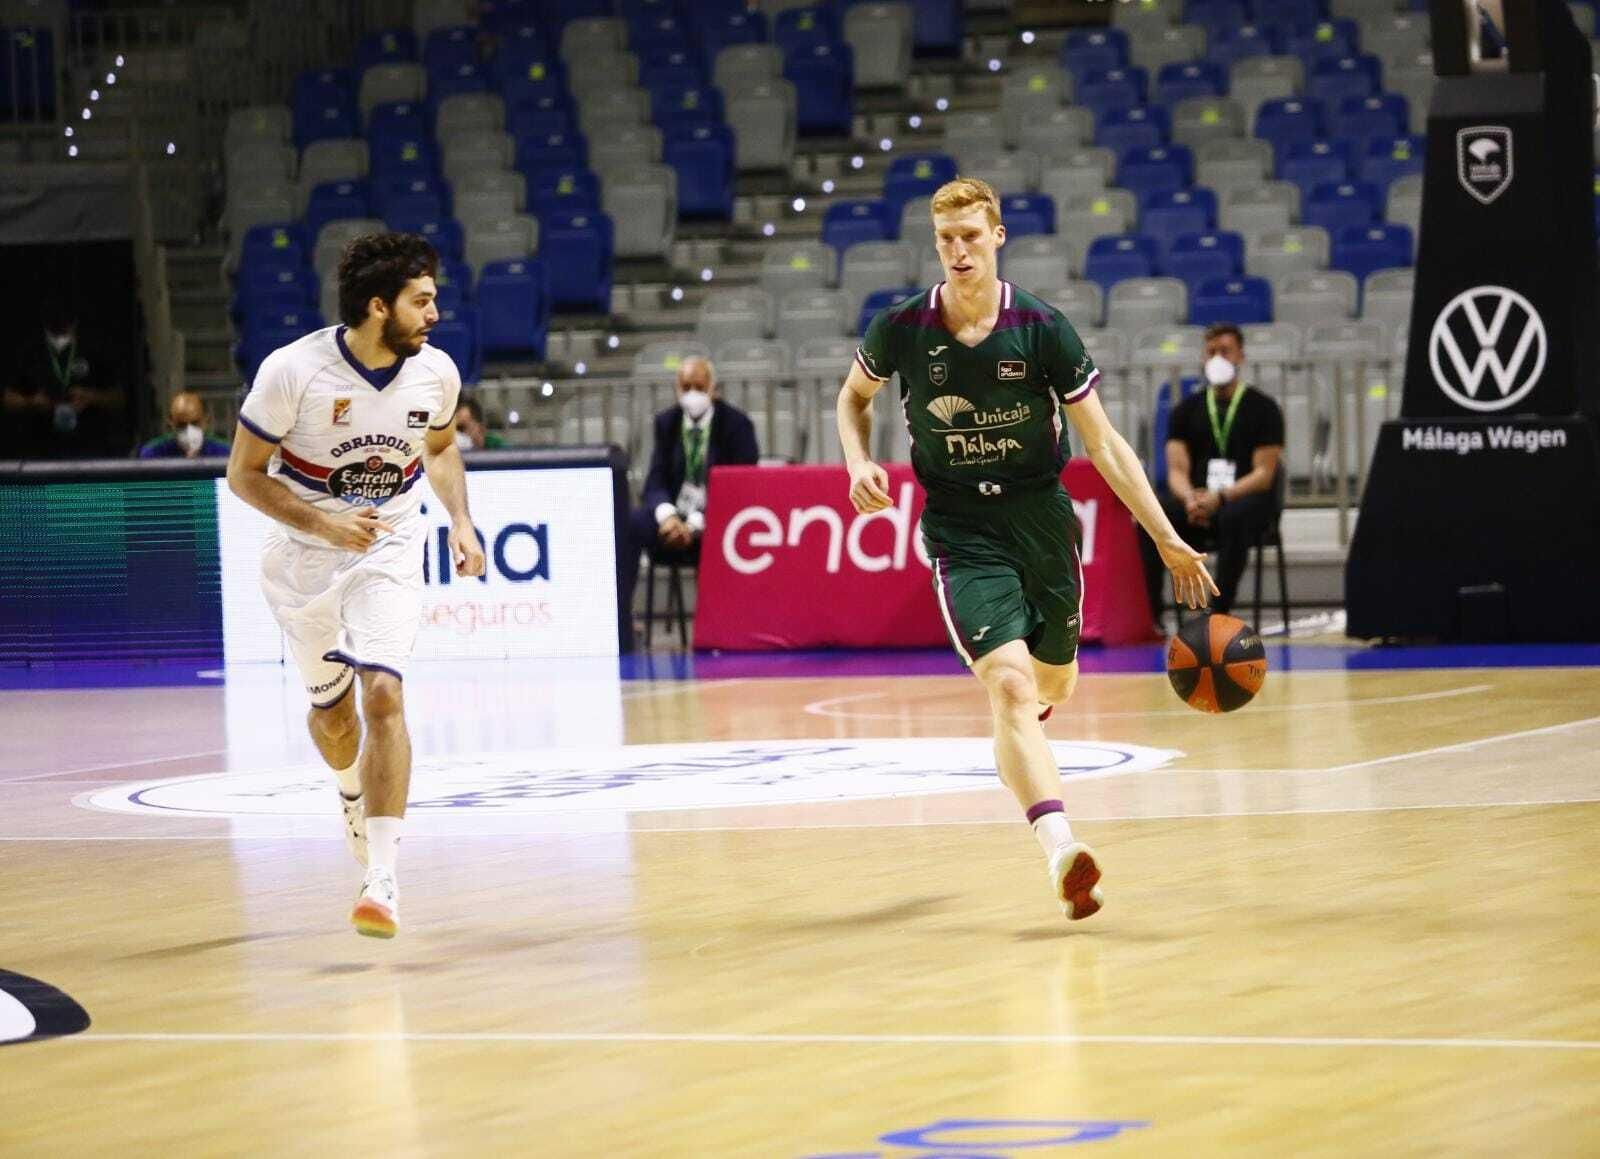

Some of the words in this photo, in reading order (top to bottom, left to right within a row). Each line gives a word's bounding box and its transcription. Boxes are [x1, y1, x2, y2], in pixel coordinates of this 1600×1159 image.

[973, 401, 1031, 425] Unicaja
[945, 432, 1023, 460] Málaga
[1402, 426, 1483, 455] Málaga
[1487, 425, 1567, 453] Wagen
[341, 469, 399, 484] Estrella
